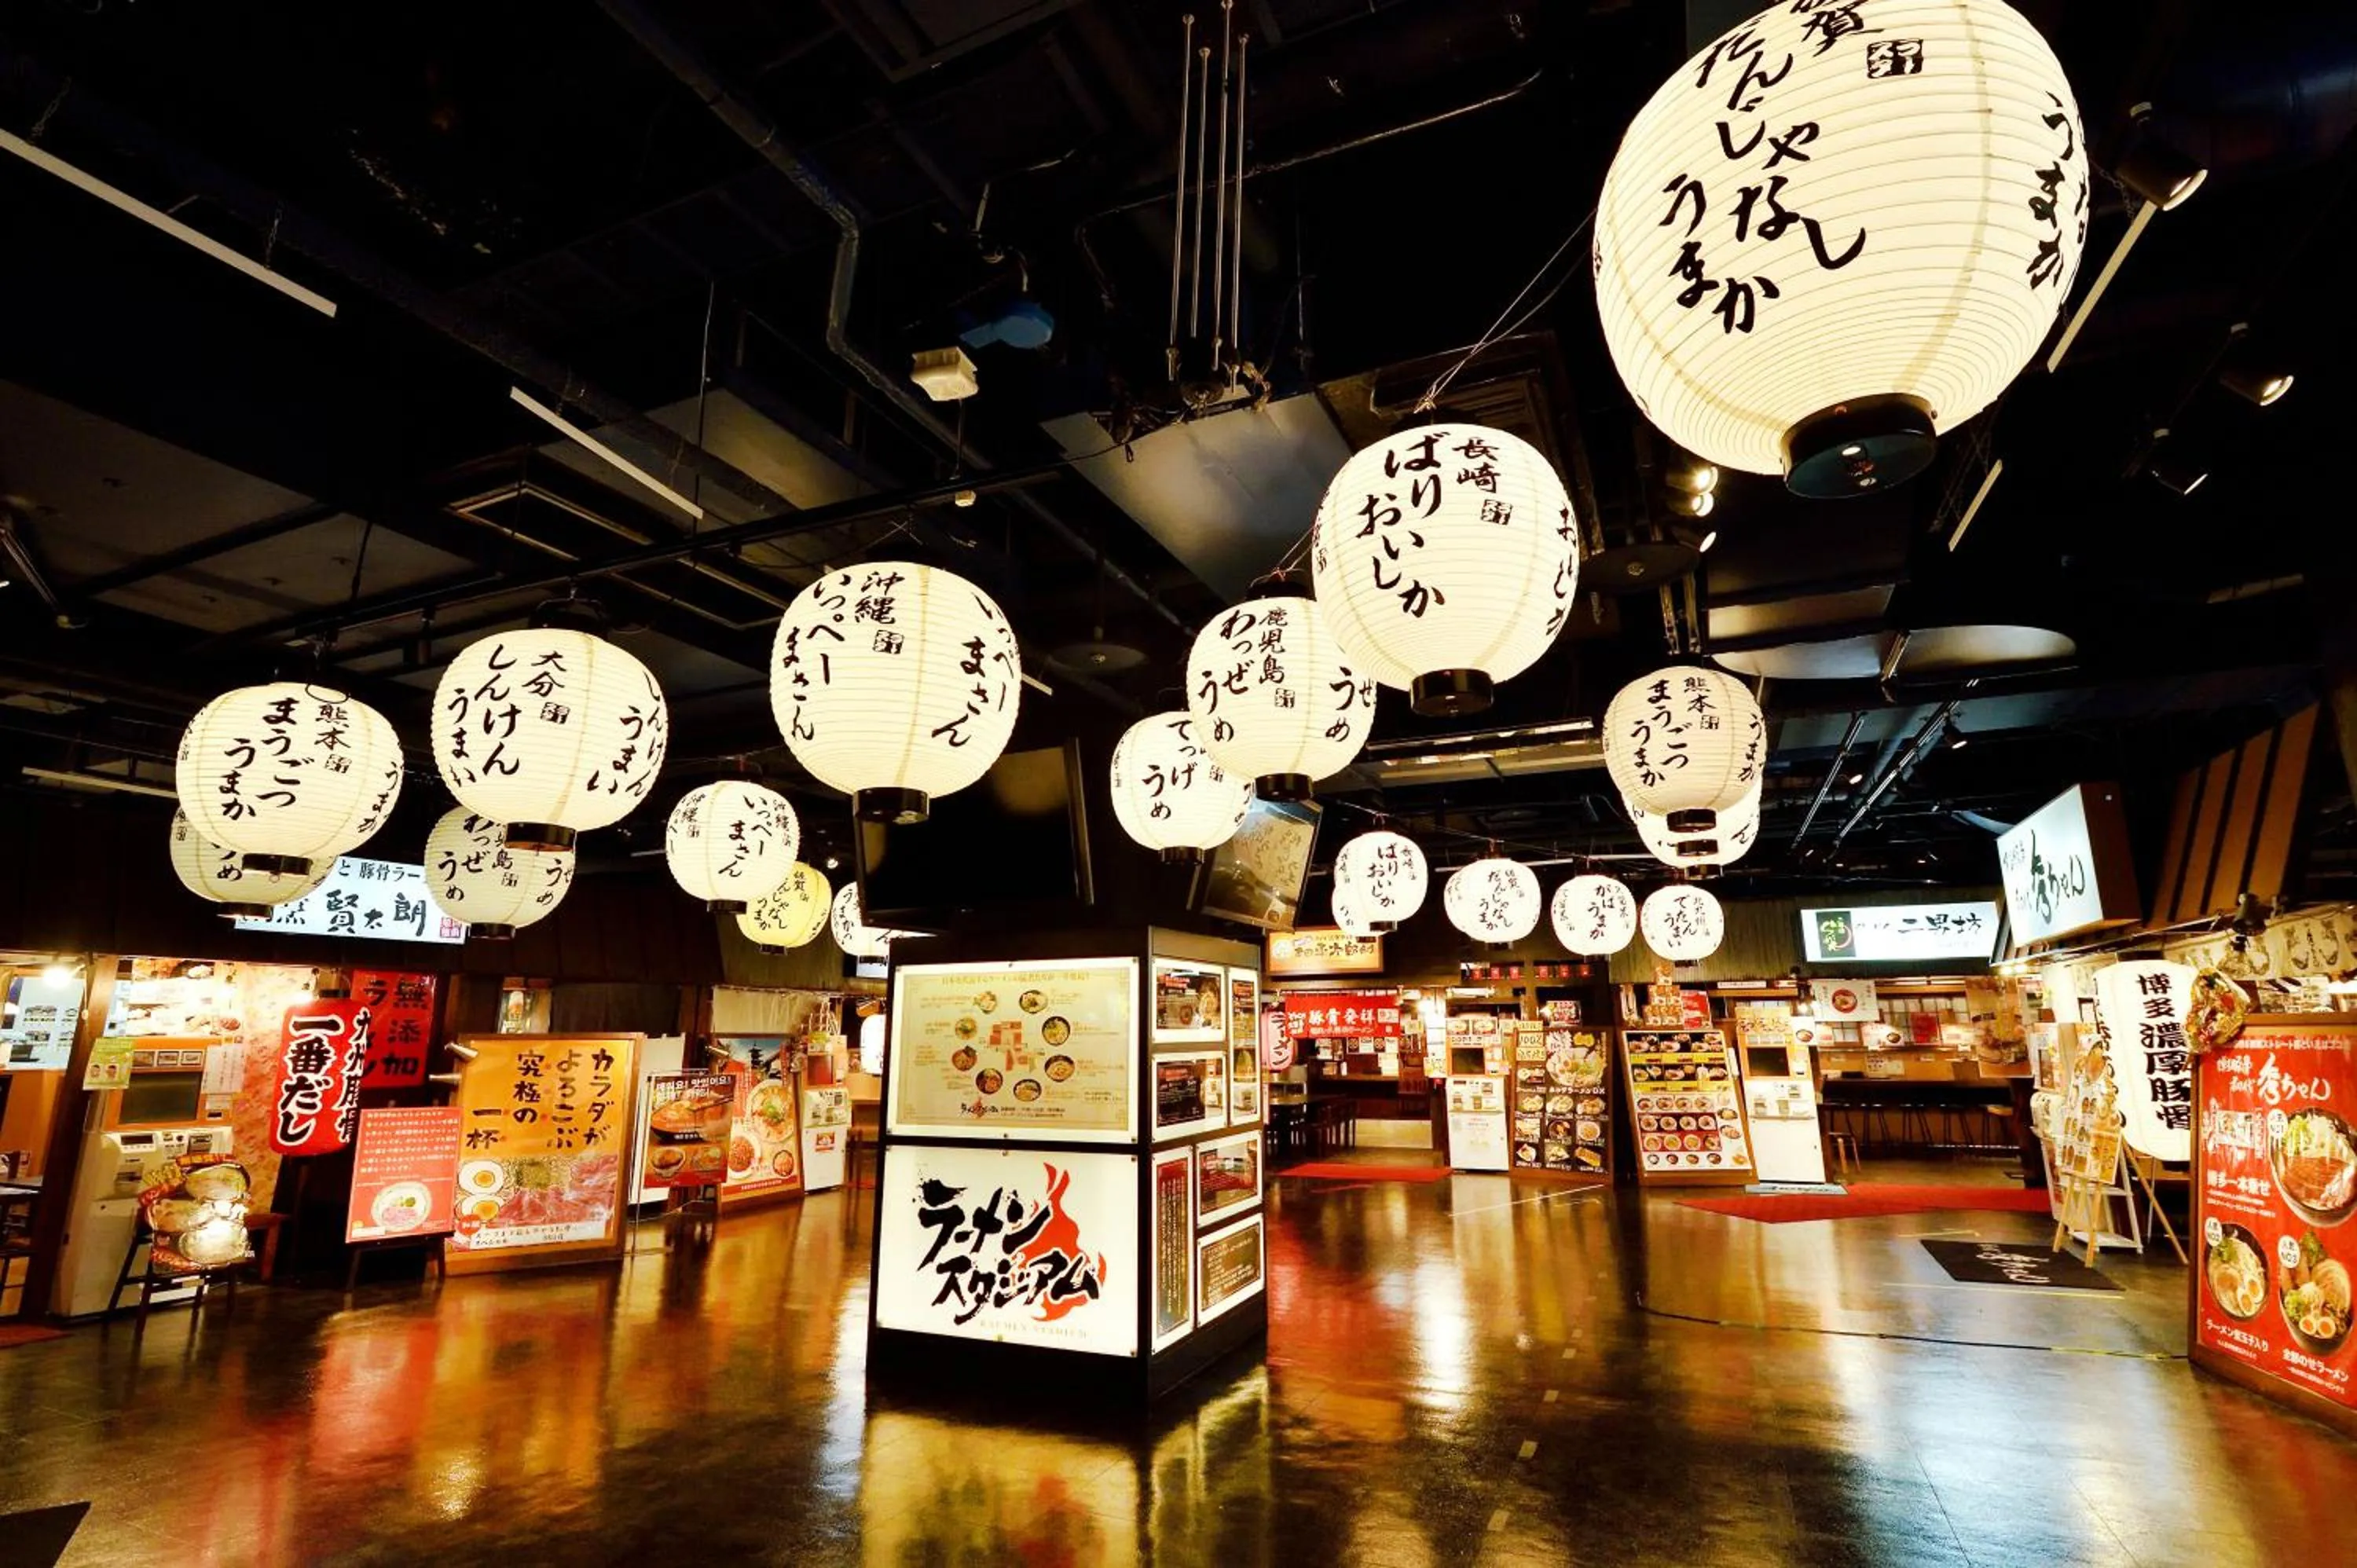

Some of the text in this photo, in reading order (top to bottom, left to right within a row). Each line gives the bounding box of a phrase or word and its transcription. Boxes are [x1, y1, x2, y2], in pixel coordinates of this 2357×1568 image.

[1384, 431, 1451, 518] ばり
[1452, 436, 1500, 493] 長崎
[1356, 493, 1445, 617] おいしか
[855, 571, 905, 625] 沖縄
[522, 650, 566, 698] 大分
[1219, 610, 1256, 695] わっぜ
[1259, 606, 1288, 684] 鹿児島
[315, 704, 351, 750] 熊本
[475, 644, 522, 776] しんけん
[1198, 670, 1235, 742] うめ
[1325, 666, 1355, 742] うめ
[1684, 677, 1717, 713] 熊本
[448, 688, 477, 786] うまい
[587, 705, 643, 794] うまい
[1630, 720, 1665, 787] うまか
[218, 738, 256, 820] うまか
[1142, 764, 1171, 819] うめ
[438, 851, 465, 901] うめ
[1897, 913, 1981, 935] 二男坊
[1271, 1014, 1290, 1065] ラーメン
[278, 1015, 344, 1145] 一番だし
[513, 1050, 545, 1123] 究極の
[548, 1049, 583, 1149] よろこぶ
[583, 1048, 615, 1146] カラダが
[467, 1108, 502, 1150] 一杯
[915, 1178, 1051, 1271] ラーメン
[932, 1251, 1100, 1325] スタジアム
